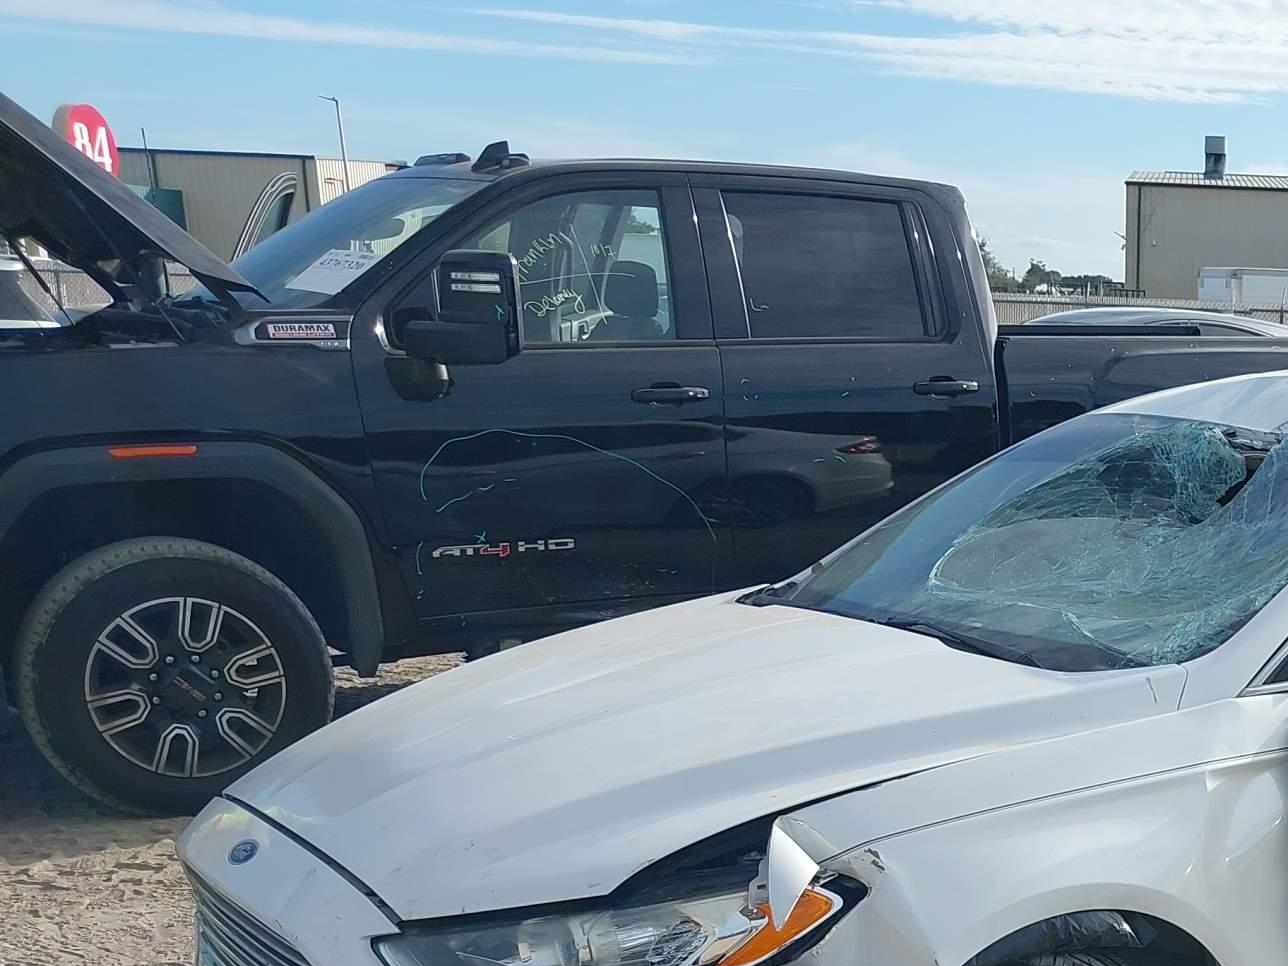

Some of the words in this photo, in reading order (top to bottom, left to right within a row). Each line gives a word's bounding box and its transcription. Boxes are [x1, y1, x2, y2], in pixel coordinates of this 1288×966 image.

[73, 121, 112, 172] 84
[272, 324, 331, 332] DURAMAX
[432, 543, 510, 557] AT4
[518, 538, 575, 552] HD
